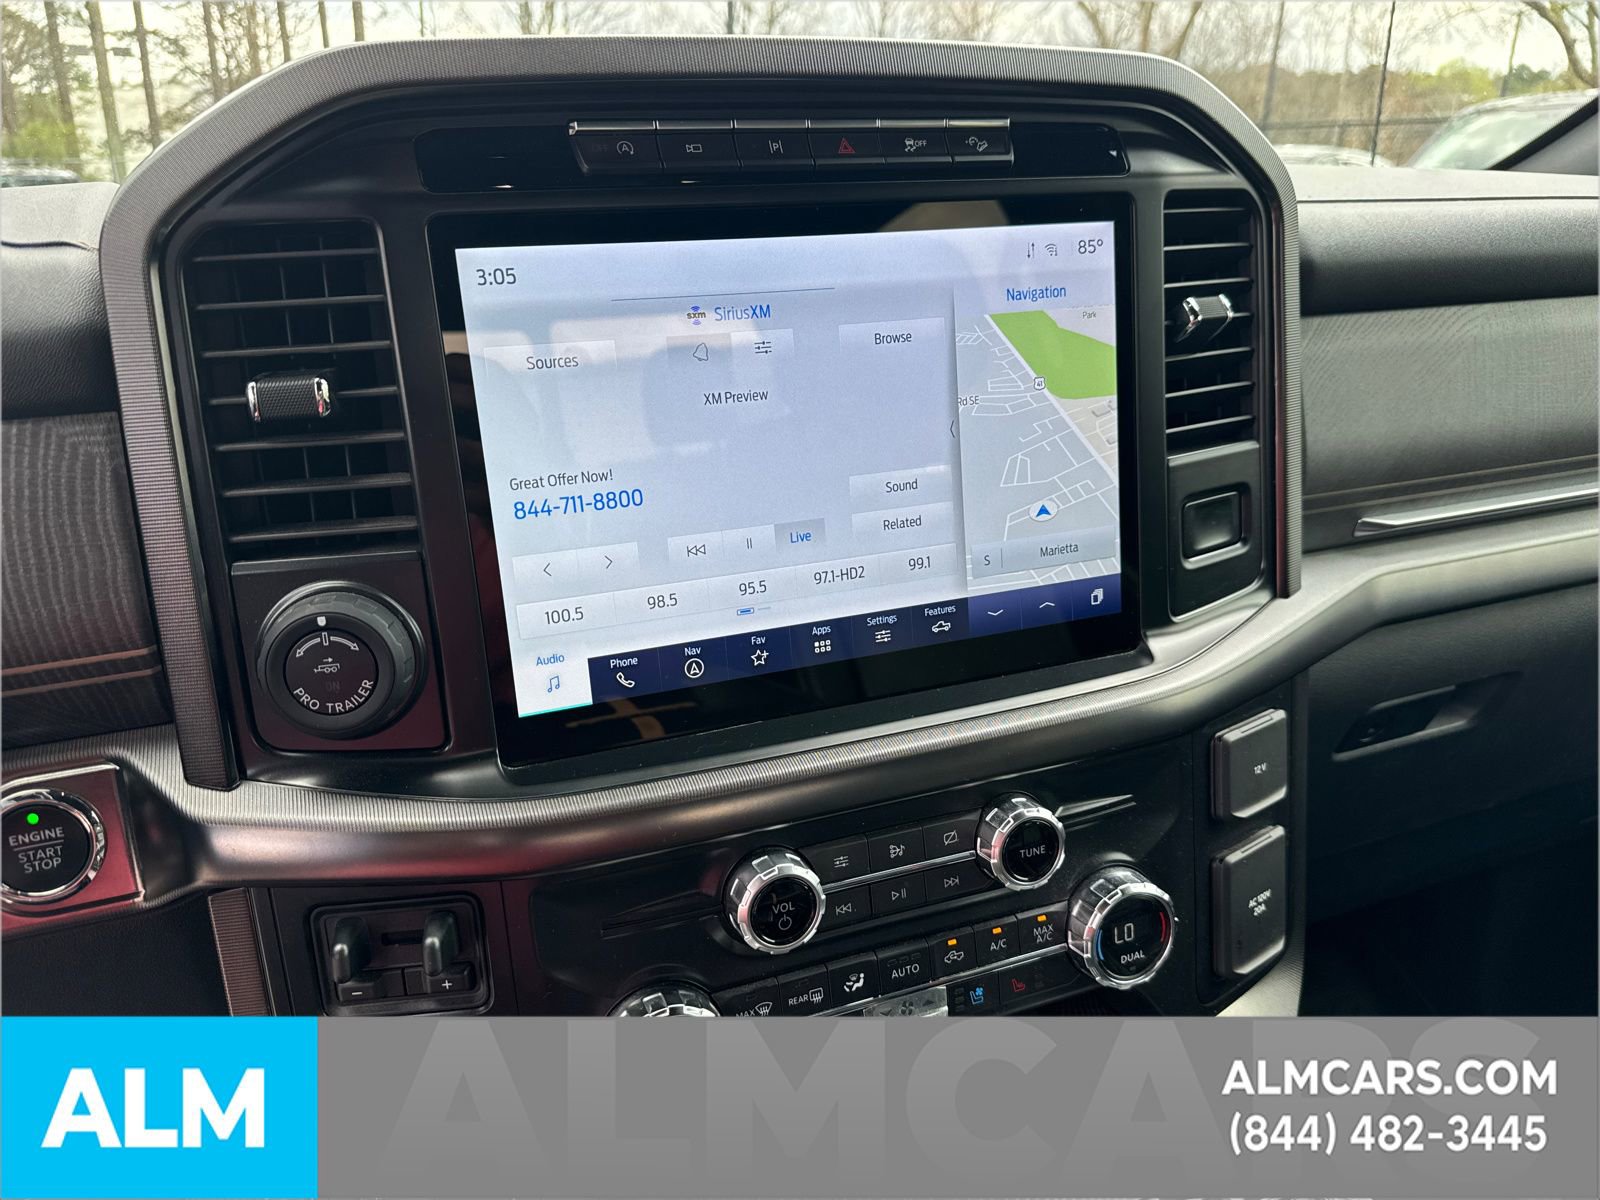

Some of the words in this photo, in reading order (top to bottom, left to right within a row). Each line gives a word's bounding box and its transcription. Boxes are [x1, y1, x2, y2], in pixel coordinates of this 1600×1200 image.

[475, 267, 517, 286] 3:05
[1006, 285, 1067, 302] Navigation
[714, 304, 771, 321] SiriusXM
[1082, 311, 1097, 319] Park
[874, 332, 912, 345] Browse
[526, 355, 579, 370] Sources
[703, 392, 723, 406] XM
[725, 389, 768, 404] Preview
[969, 396, 980, 405] SE
[509, 475, 545, 491] Great
[547, 472, 579, 488] Offer
[580, 468, 614, 484] Now!
[885, 478, 918, 493] Sound
[513, 488, 644, 520] 844-711-8800
[883, 516, 922, 531] Related
[789, 530, 812, 543] Live
[1039, 542, 1079, 558] Marietta
[908, 555, 931, 571] 99.1
[983, 555, 991, 566] S
[813, 565, 865, 585] 97.1-HD2
[738, 580, 768, 596] 95.5
[646, 592, 679, 610] 98.5
[544, 606, 585, 625] 100.5
[924, 604, 957, 617] Features
[866, 613, 898, 628] Settings
[811, 624, 832, 637] Apps
[750, 635, 766, 646] Fav
[684, 646, 702, 656] Nav
[535, 653, 565, 667] Audio
[609, 656, 639, 670] Phone
[293, 687, 321, 711] PRO
[325, 679, 374, 714] TRAILER
[8, 826, 65, 847] ENGINE
[18, 845, 63, 863] START
[1019, 845, 1047, 859] TUNE
[23, 857, 62, 874] STOP
[771, 901, 796, 915] VOL
[1253, 903, 1267, 917] 20A
[1033, 923, 1054, 937] MAX
[1036, 931, 1053, 943] A/C
[990, 938, 1008, 951] A/C
[1120, 950, 1146, 964] DUAL
[891, 963, 920, 980] AUTO
[788, 993, 810, 1007] REAR
